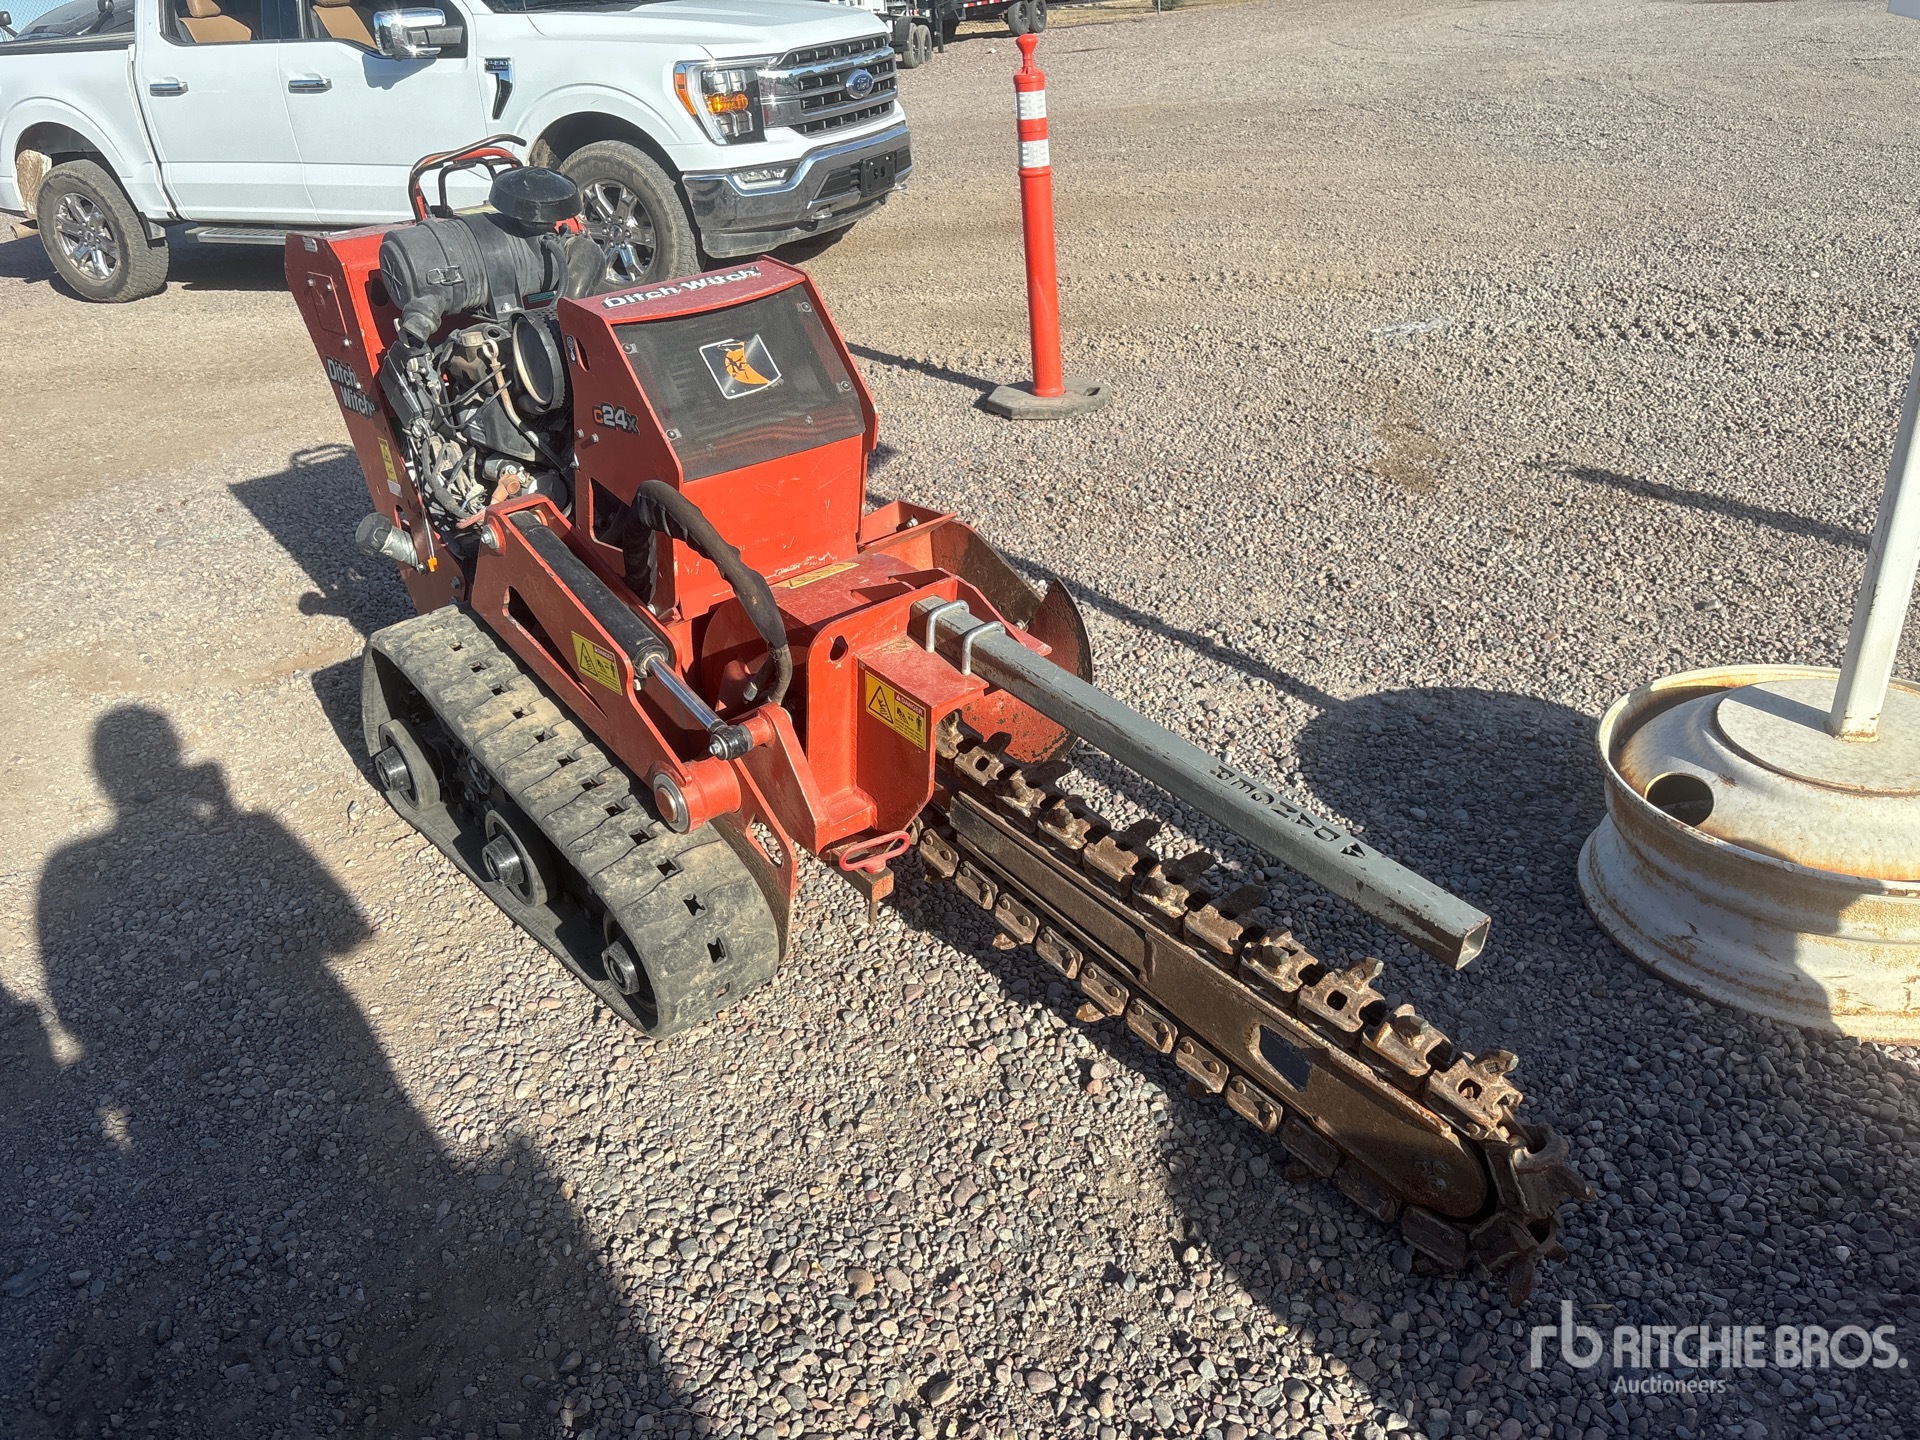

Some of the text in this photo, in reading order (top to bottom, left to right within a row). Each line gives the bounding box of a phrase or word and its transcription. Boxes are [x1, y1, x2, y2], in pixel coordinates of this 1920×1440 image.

[602, 267, 759, 308] Ditch Witch
[327, 358, 357, 387] Ditch
[340, 385, 373, 416] Witch
[901, 698, 923, 716] DANGER
[1208, 765, 1341, 842] DANGER
